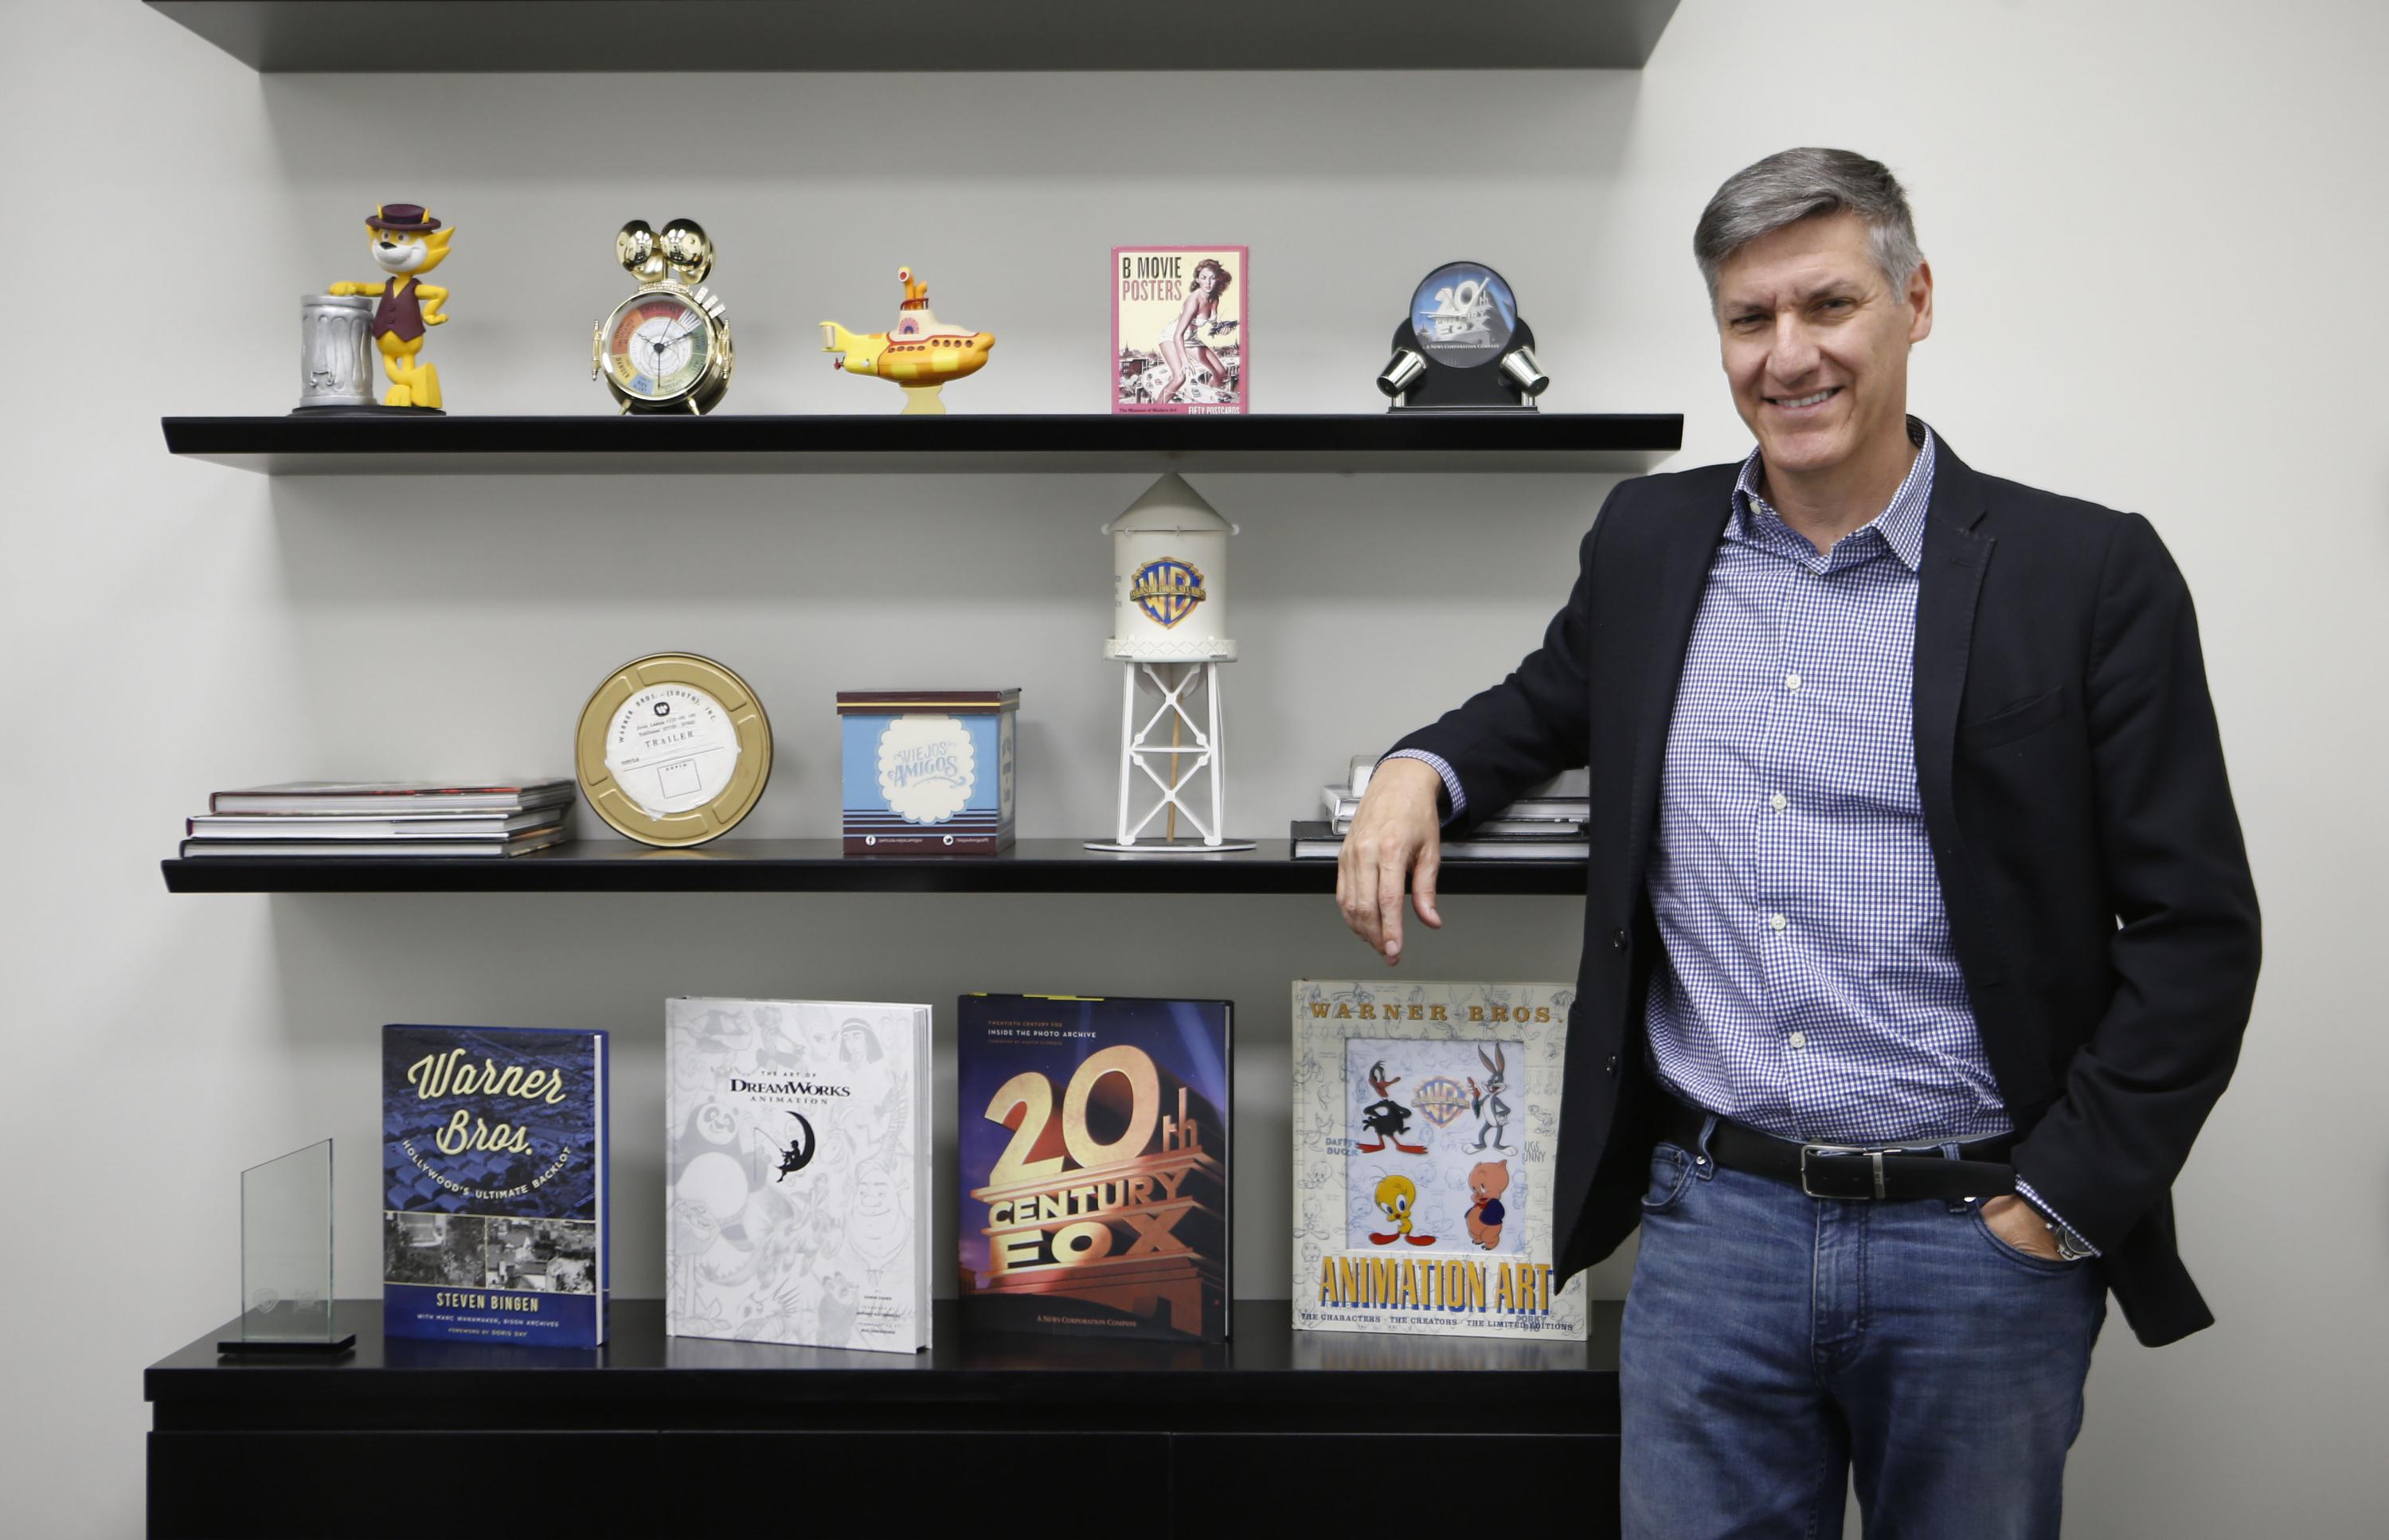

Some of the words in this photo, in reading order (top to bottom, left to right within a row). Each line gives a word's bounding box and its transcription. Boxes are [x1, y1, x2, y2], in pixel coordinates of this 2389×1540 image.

[1122, 257, 1131, 279] B
[1137, 257, 1182, 279] MOVIE
[1122, 279, 1182, 302] POSTERS
[619, 710, 633, 743] WARNER
[705, 706, 716, 722] INC.
[644, 730, 694, 749] TRAILER
[893, 741, 947, 764] VIEJOS
[887, 756, 958, 788] AMIGOS
[1310, 1003, 1448, 1022] WARNER
[1468, 1005, 1563, 1024] BROS.
[408, 1048, 566, 1104] Warner
[750, 1096, 828, 1105] ANIMATION
[984, 1045, 1198, 1186] 20th
[436, 1109, 533, 1155] Bros.
[1326, 1147, 1359, 1156] DUCK
[401, 1139, 470, 1196] HOLLYWOOD'S
[475, 1184, 530, 1200] ULTIMATE
[531, 1147, 573, 1189] BACKLOT
[988, 1167, 1193, 1228] CENTURY
[990, 1206, 1192, 1275] FOX
[1319, 1256, 1486, 1312] ANIMATION
[1494, 1261, 1553, 1315] ART
[436, 1292, 486, 1308] STEVEN
[491, 1296, 539, 1311] BINGEN
[1062, 1316, 1105, 1325] CORPORATION
[1320, 1314, 1381, 1323] CHARACTERS
[1410, 1317, 1457, 1326] CREATORS
